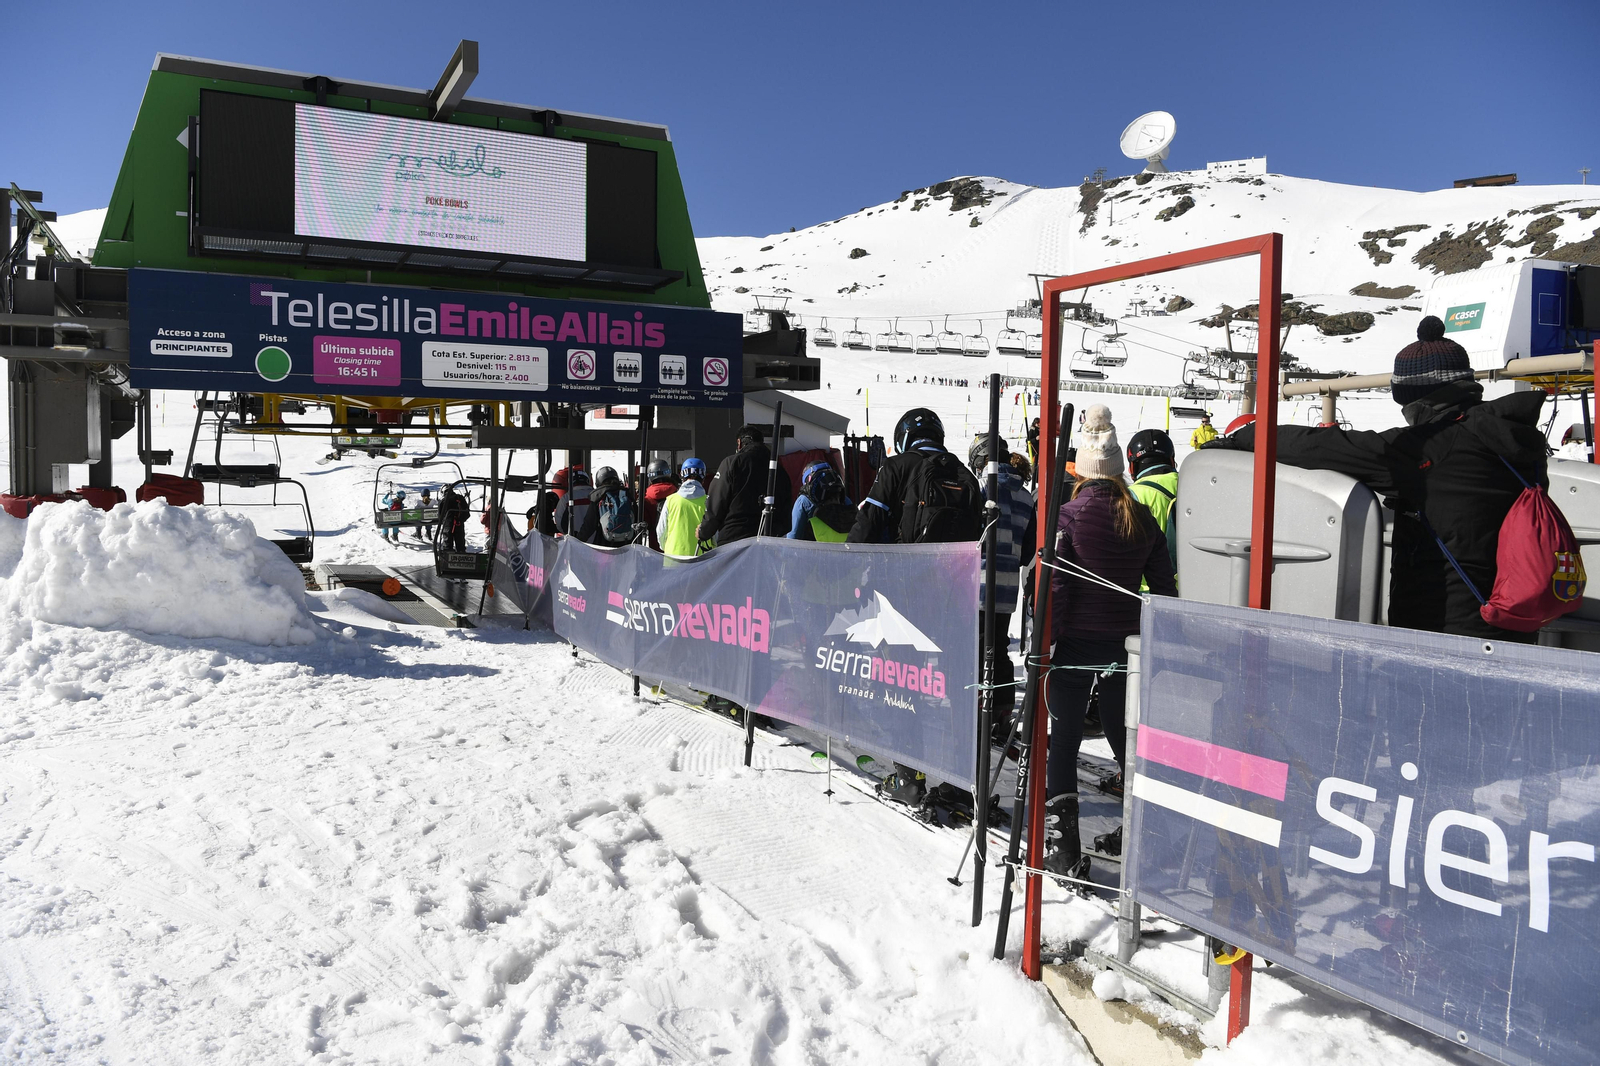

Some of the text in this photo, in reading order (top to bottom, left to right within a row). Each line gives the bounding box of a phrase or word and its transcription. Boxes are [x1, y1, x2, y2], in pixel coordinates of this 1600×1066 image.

[445, 198, 469, 209] BOWLS
[1455, 309, 1480, 320] caser
[157, 327, 191, 337] Acceso
[202, 331, 226, 339] zona
[259, 333, 288, 343] Pistas
[155, 343, 228, 353] PRINCIPIANTES
[320, 342, 394, 356] Última subida
[333, 356, 362, 365] Closing
[432, 350, 450, 358] Cota
[452, 351, 468, 359] Est.
[470, 352, 507, 361] Superior:
[508, 353, 531, 362] 2.813
[338, 366, 378, 377] 16:45 h
[456, 361, 493, 370] Desnivel:
[495, 363, 507, 371] 115
[443, 371, 529, 382] Usuarios/hora: 2.400
[838, 683, 875, 700] granada
[1018, 748, 1028, 796] LISKI
